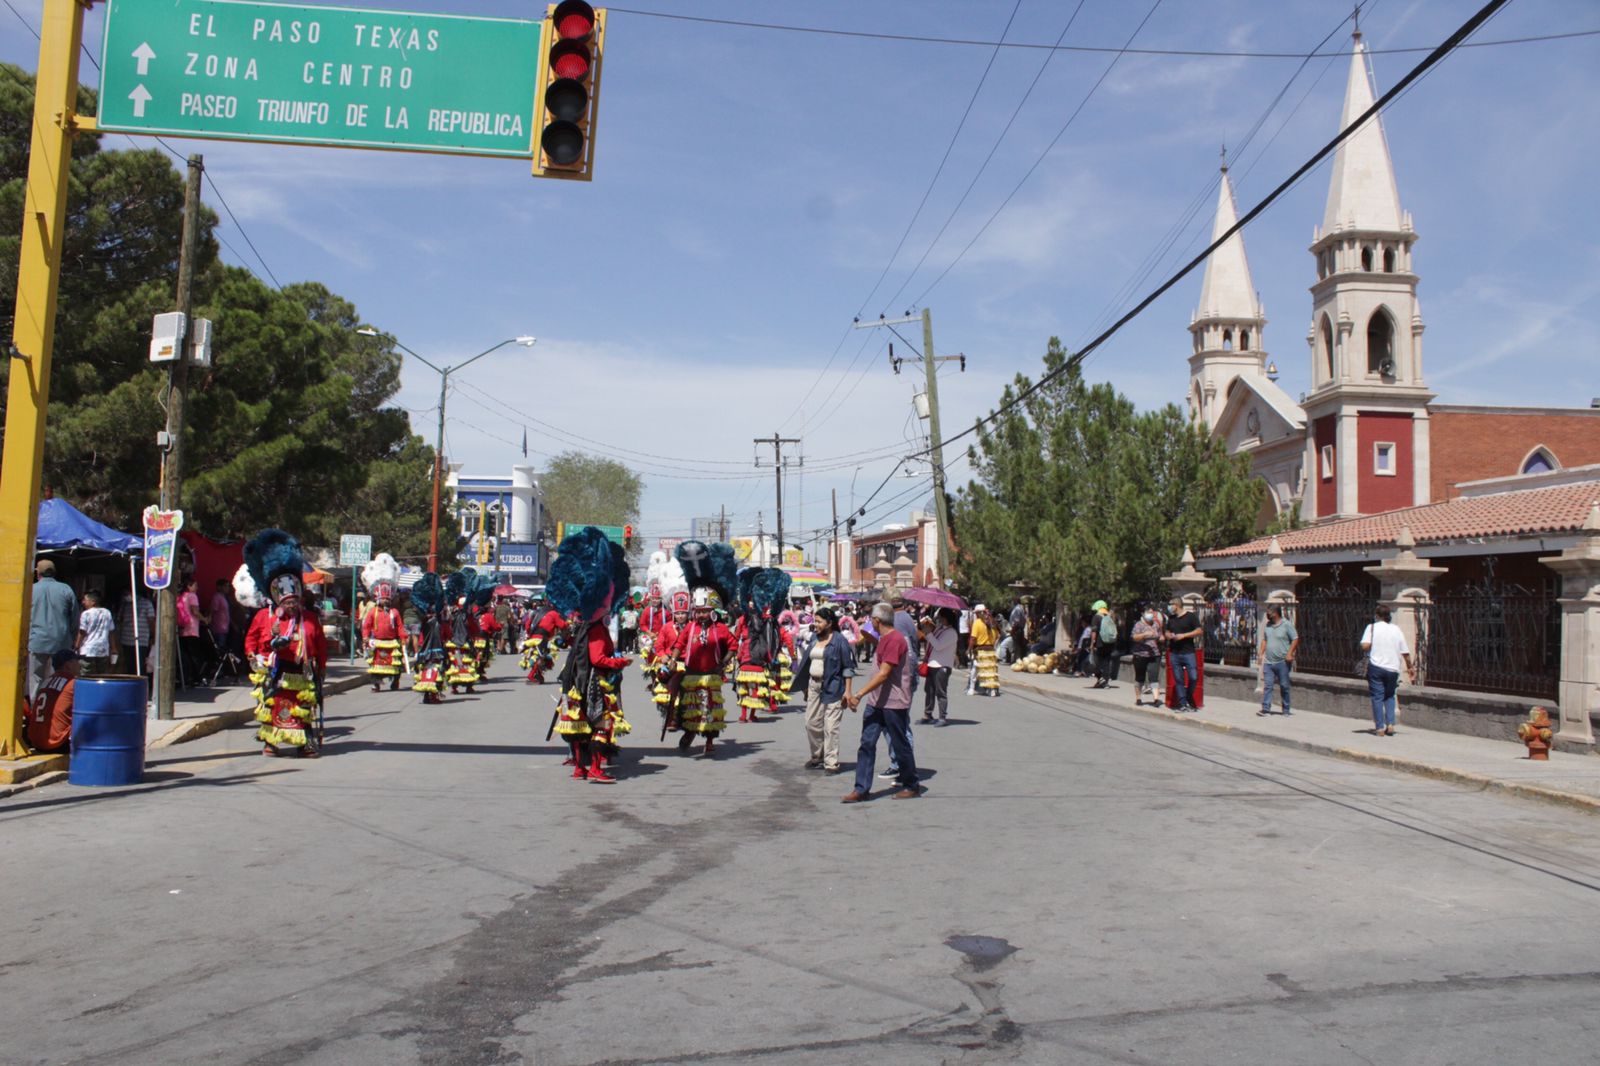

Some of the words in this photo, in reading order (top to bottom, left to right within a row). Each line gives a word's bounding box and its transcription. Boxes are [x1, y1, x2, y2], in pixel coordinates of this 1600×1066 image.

[189, 13, 217, 37] EL
[252, 18, 320, 44] PASO
[354, 24, 439, 52] TEXAS
[184, 52, 258, 81] ZONA
[303, 61, 413, 90] CENTRO
[180, 92, 238, 119] PASEO
[257, 98, 330, 125] TRIUNFO
[345, 103, 369, 127] DE
[384, 105, 409, 129] LA
[428, 108, 523, 137] REPUBLICA
[499, 554, 533, 564] UEBLO
